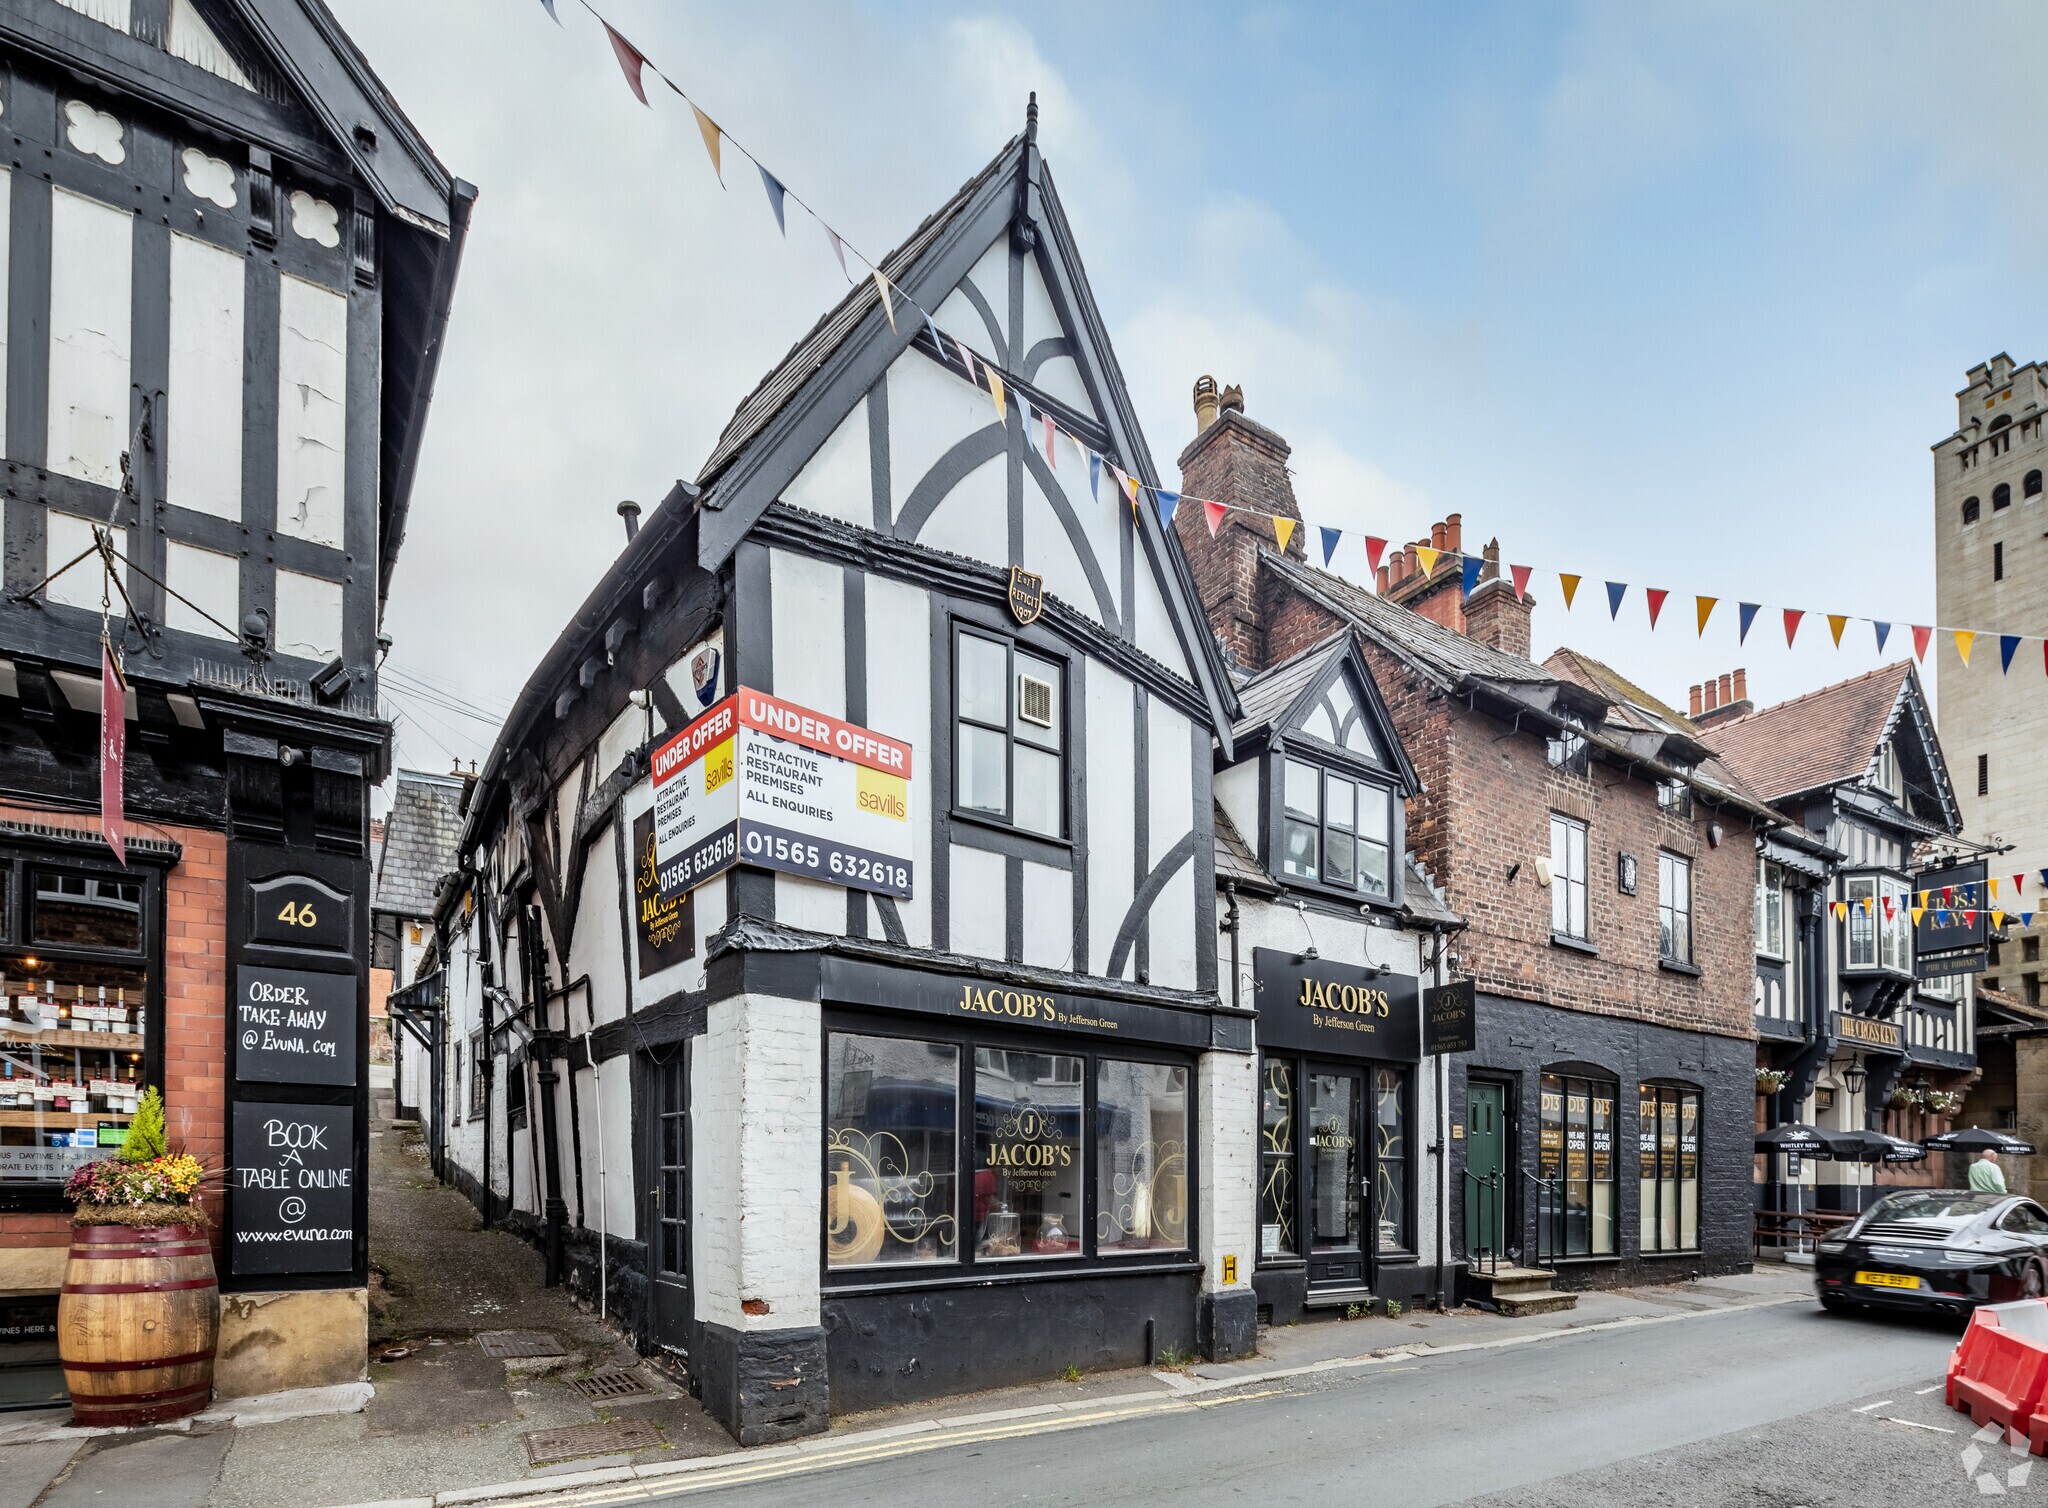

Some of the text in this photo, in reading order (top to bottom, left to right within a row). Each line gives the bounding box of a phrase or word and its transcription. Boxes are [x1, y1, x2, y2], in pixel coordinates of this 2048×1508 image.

[1016, 605, 1032, 619] 1907
[655, 738, 691, 777] UNDER
[692, 708, 732, 751] OFFER
[749, 698, 830, 745] UNDER
[835, 730, 904, 770] OFFER
[746, 742, 819, 773] ATTRACTIVE
[706, 757, 733, 791] savills
[746, 756, 824, 787] RESTAURANT
[656, 775, 688, 804] ATTRACTIVE
[746, 769, 804, 796] PREMISES
[656, 787, 690, 817] RESTAURANT
[746, 789, 834, 822] ALL ENQUIRIES
[859, 790, 905, 818] savills
[657, 806, 682, 829] PREMISES
[658, 815, 696, 846] ALL ENQUIRIES
[659, 832, 735, 893] 01565 632618
[746, 831, 908, 888] 01565 632618
[277, 901, 317, 928] 46
[1926, 963, 1940, 972] PUB
[1951, 958, 1977, 969] ROOMS
[249, 981, 309, 1006] ORDER
[1300, 977, 1389, 1018] JACOB'S
[959, 985, 1118, 1030] JACOB'S By Jefferson Green
[1431, 1009, 1466, 1022] JACOB'S
[239, 1005, 327, 1030] TAKE-AWAY
[1313, 1014, 1375, 1033] By Jefferson Green
[242, 1030, 259, 1050] @
[1840, 1016, 1899, 1046] THE CROSS KEYS
[1542, 1096, 1560, 1112] D13
[1567, 1098, 1586, 1113] D13
[1593, 1099, 1611, 1115] D13
[1640, 1102, 1656, 1117] D13
[1661, 1104, 1676, 1119] D13
[1682, 1106, 1696, 1119] D13
[263, 1119, 328, 1150] BOOK
[1315, 1134, 1353, 1148] JACOB'S
[1568, 1131, 1586, 1140] WE ARE
[1593, 1132, 1610, 1141] WE ARE
[1640, 1133, 1655, 1142] WE ARE
[1681, 1135, 1688, 1143] WE
[1568, 1140, 1586, 1150] OPEN
[1593, 1141, 1610, 1151] OPEN
[1640, 1142, 1656, 1151] OPEN
[1681, 1143, 1696, 1152] OPEN
[19, 1152, 53, 1160] DAYTIME
[57, 1152, 93, 1160] SPCIALS
[279, 1149, 303, 1166] A
[986, 1143, 1071, 1167] JACOB'S
[0, 1163, 21, 1171] RATE
[25, 1163, 54, 1171] EVENTS
[1002, 1168, 1057, 1178] By Jefferson Green
[236, 1168, 352, 1189] TABLE ONLINE
[279, 1196, 306, 1224] @
[236, 1228, 353, 1243] www.evuna.com
[24, 1325, 45, 1334] HERE
